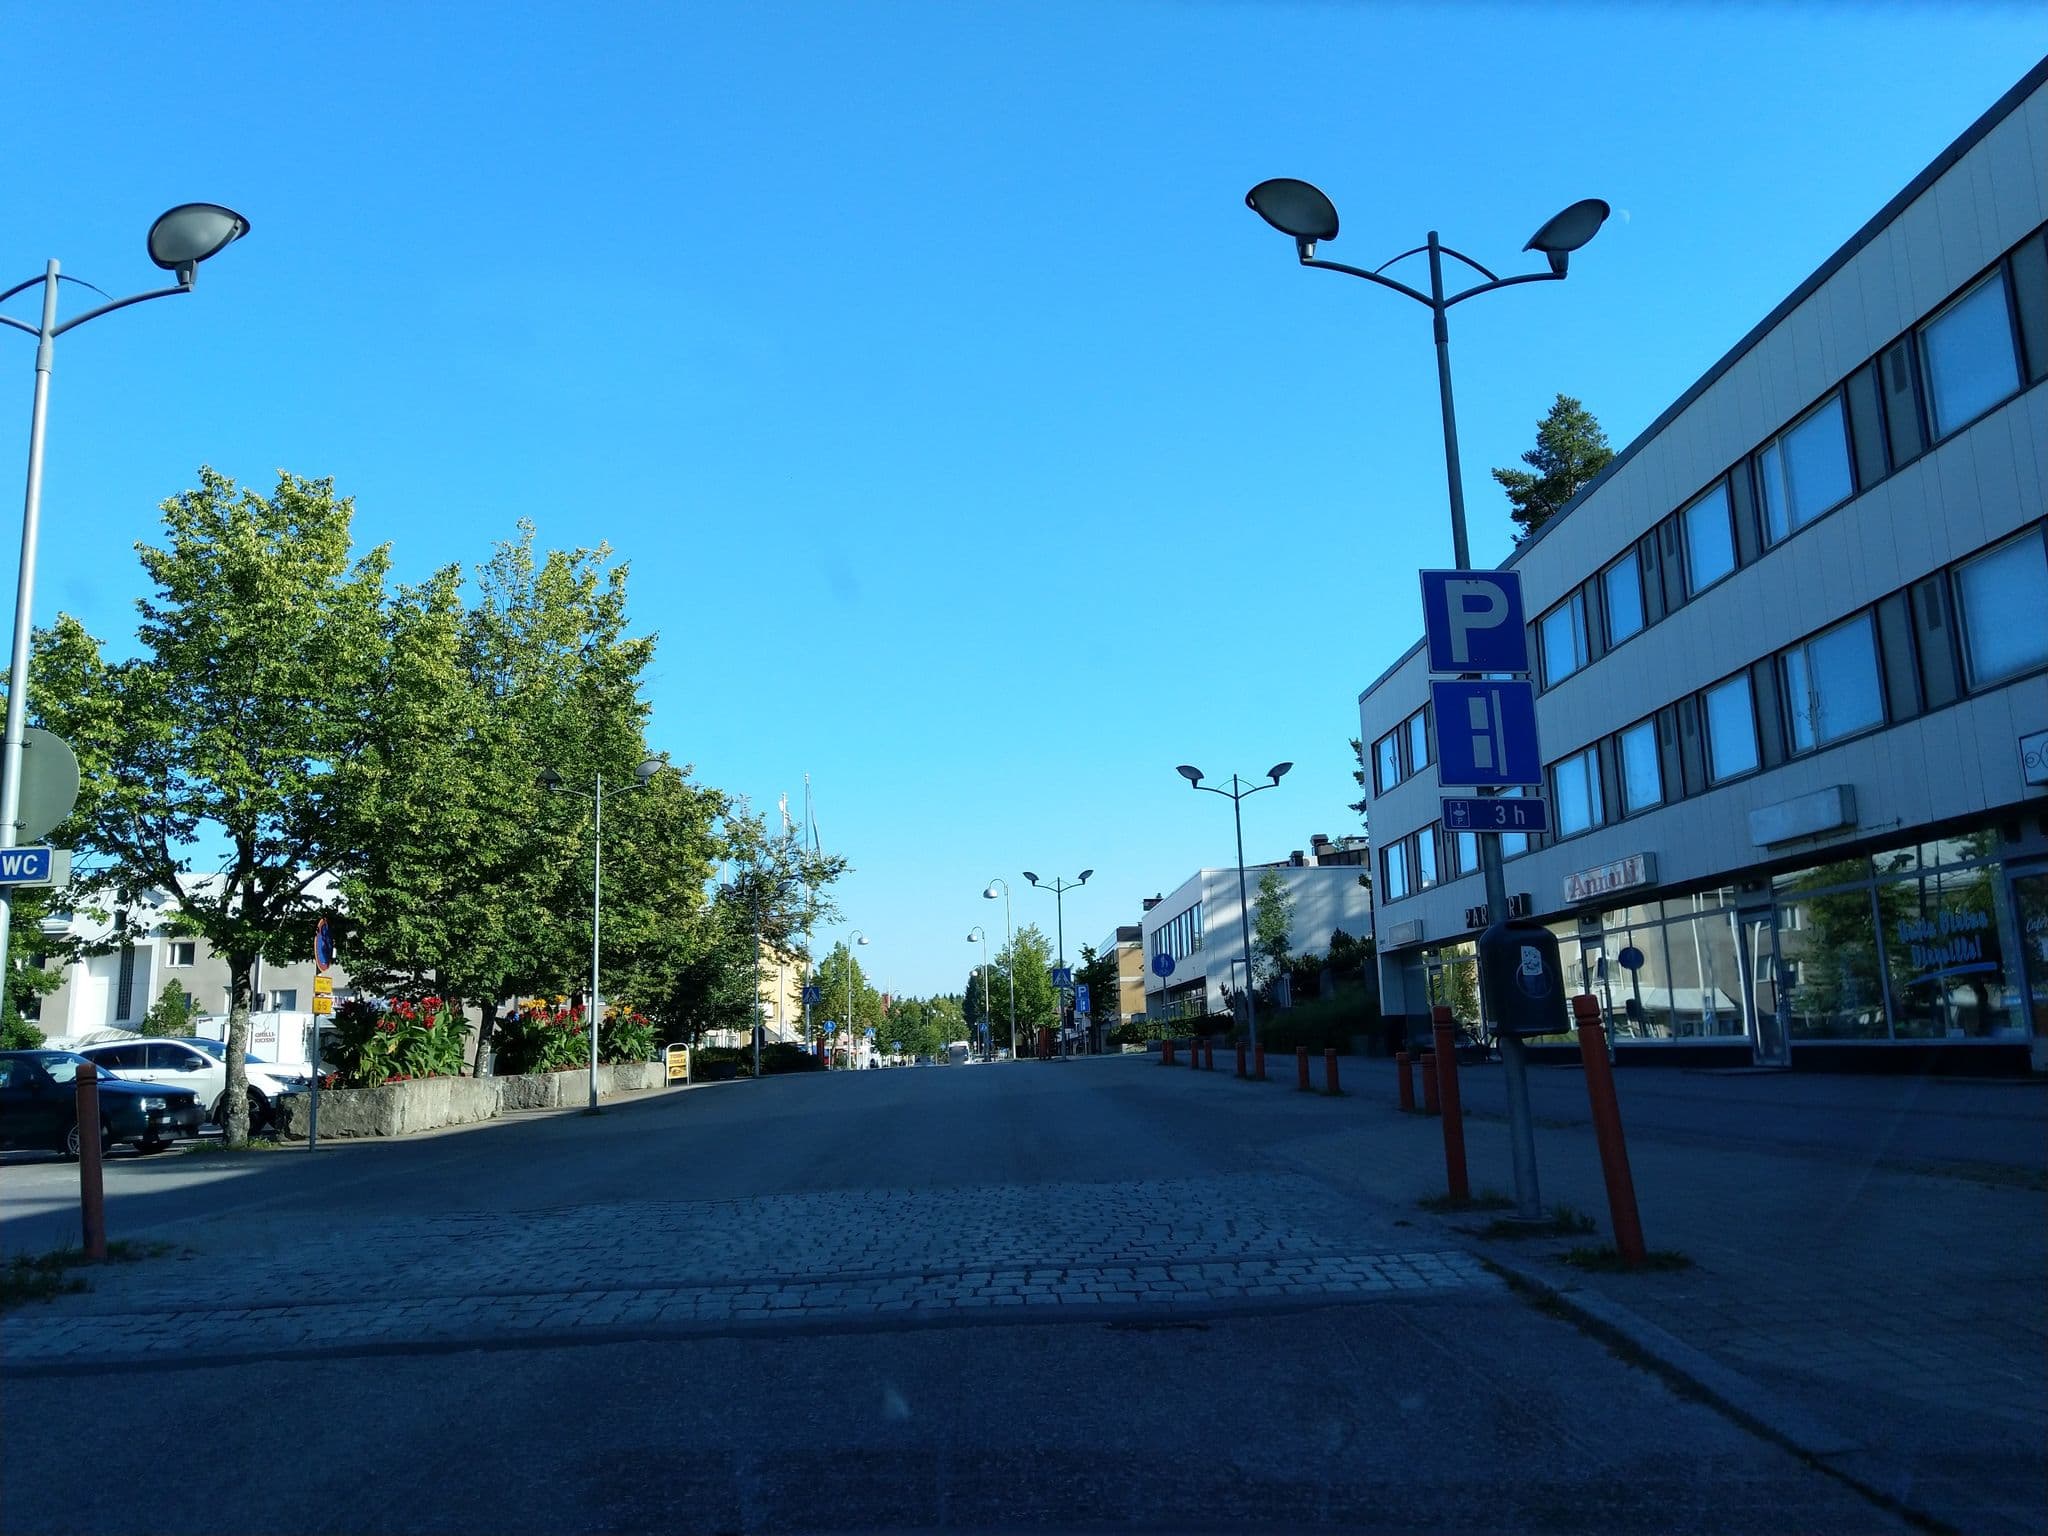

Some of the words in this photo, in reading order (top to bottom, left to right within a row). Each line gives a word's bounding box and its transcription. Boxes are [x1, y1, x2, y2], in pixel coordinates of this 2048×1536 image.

[1445, 580, 1509, 663] P
[1495, 805, 1506, 825] 3
[1514, 805, 1526, 825] h
[2, 854, 38, 876] WC
[1078, 986, 1087, 998] P
